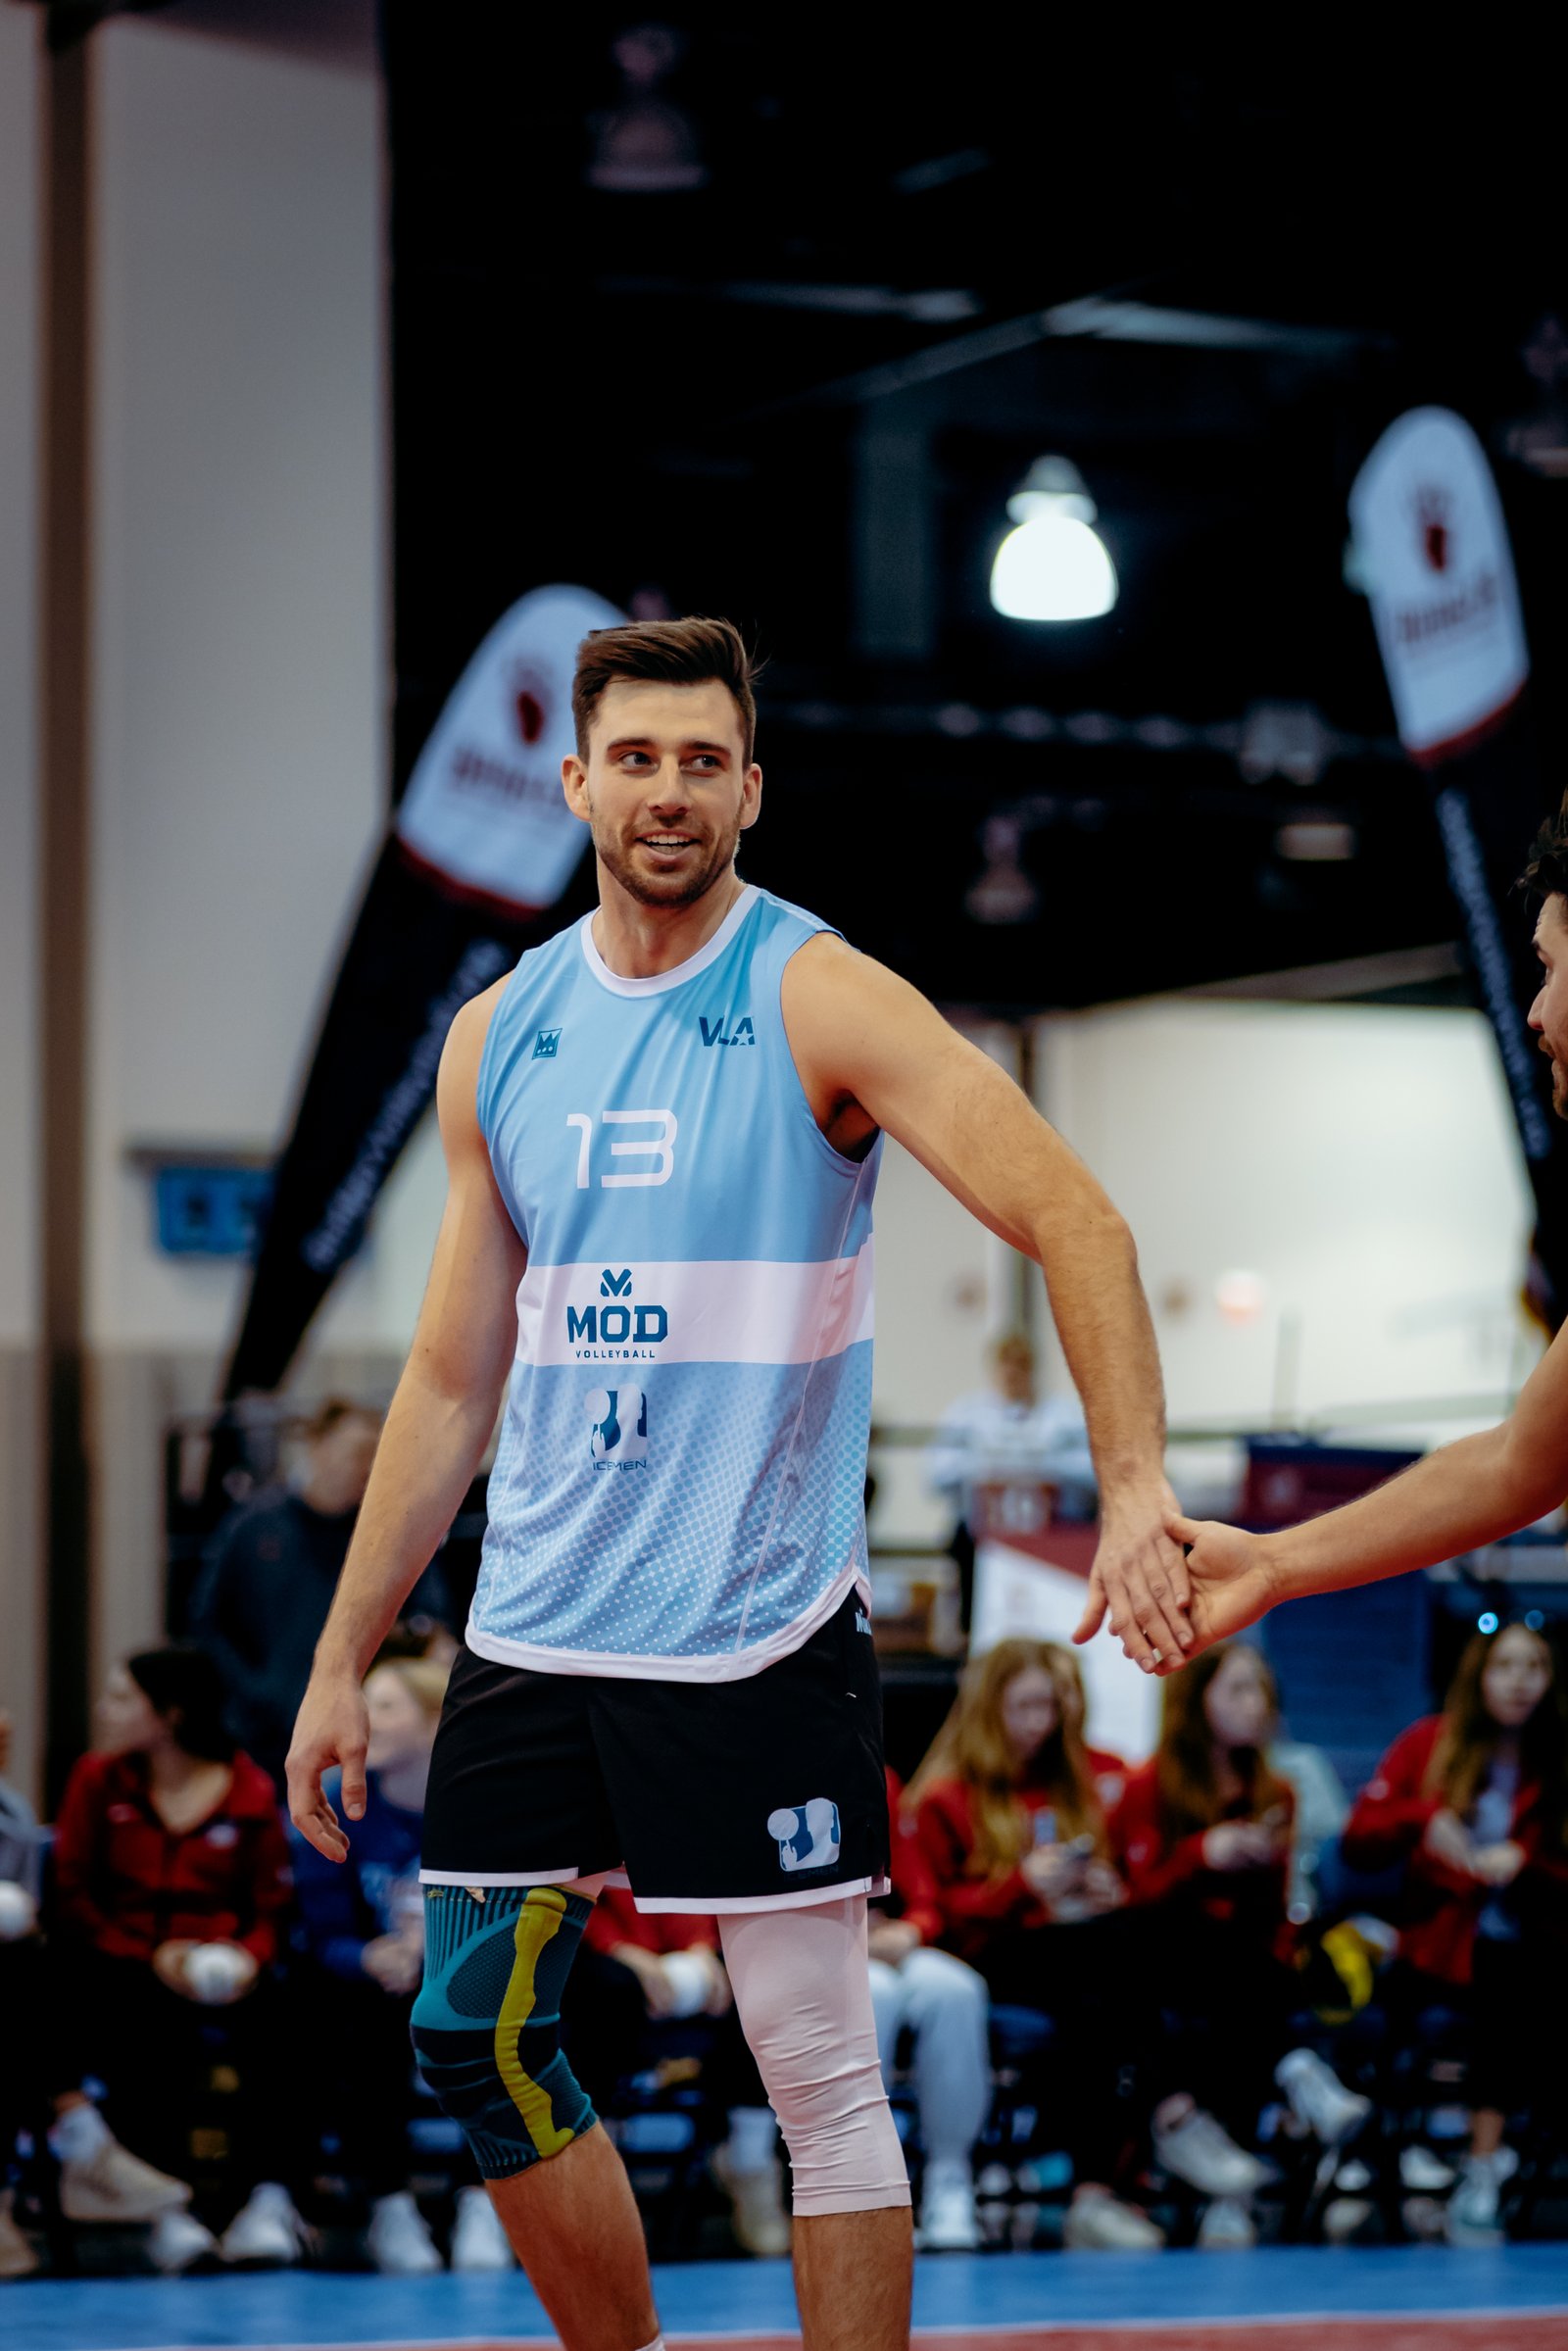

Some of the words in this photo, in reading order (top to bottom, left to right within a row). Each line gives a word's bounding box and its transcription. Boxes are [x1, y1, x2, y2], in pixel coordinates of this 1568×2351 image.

[566, 1108, 678, 1189] 13
[566, 1304, 668, 1344] MOD
[575, 1349, 656, 1359] VOLLEYBALL
[593, 1459, 647, 1471] ICEMEN
